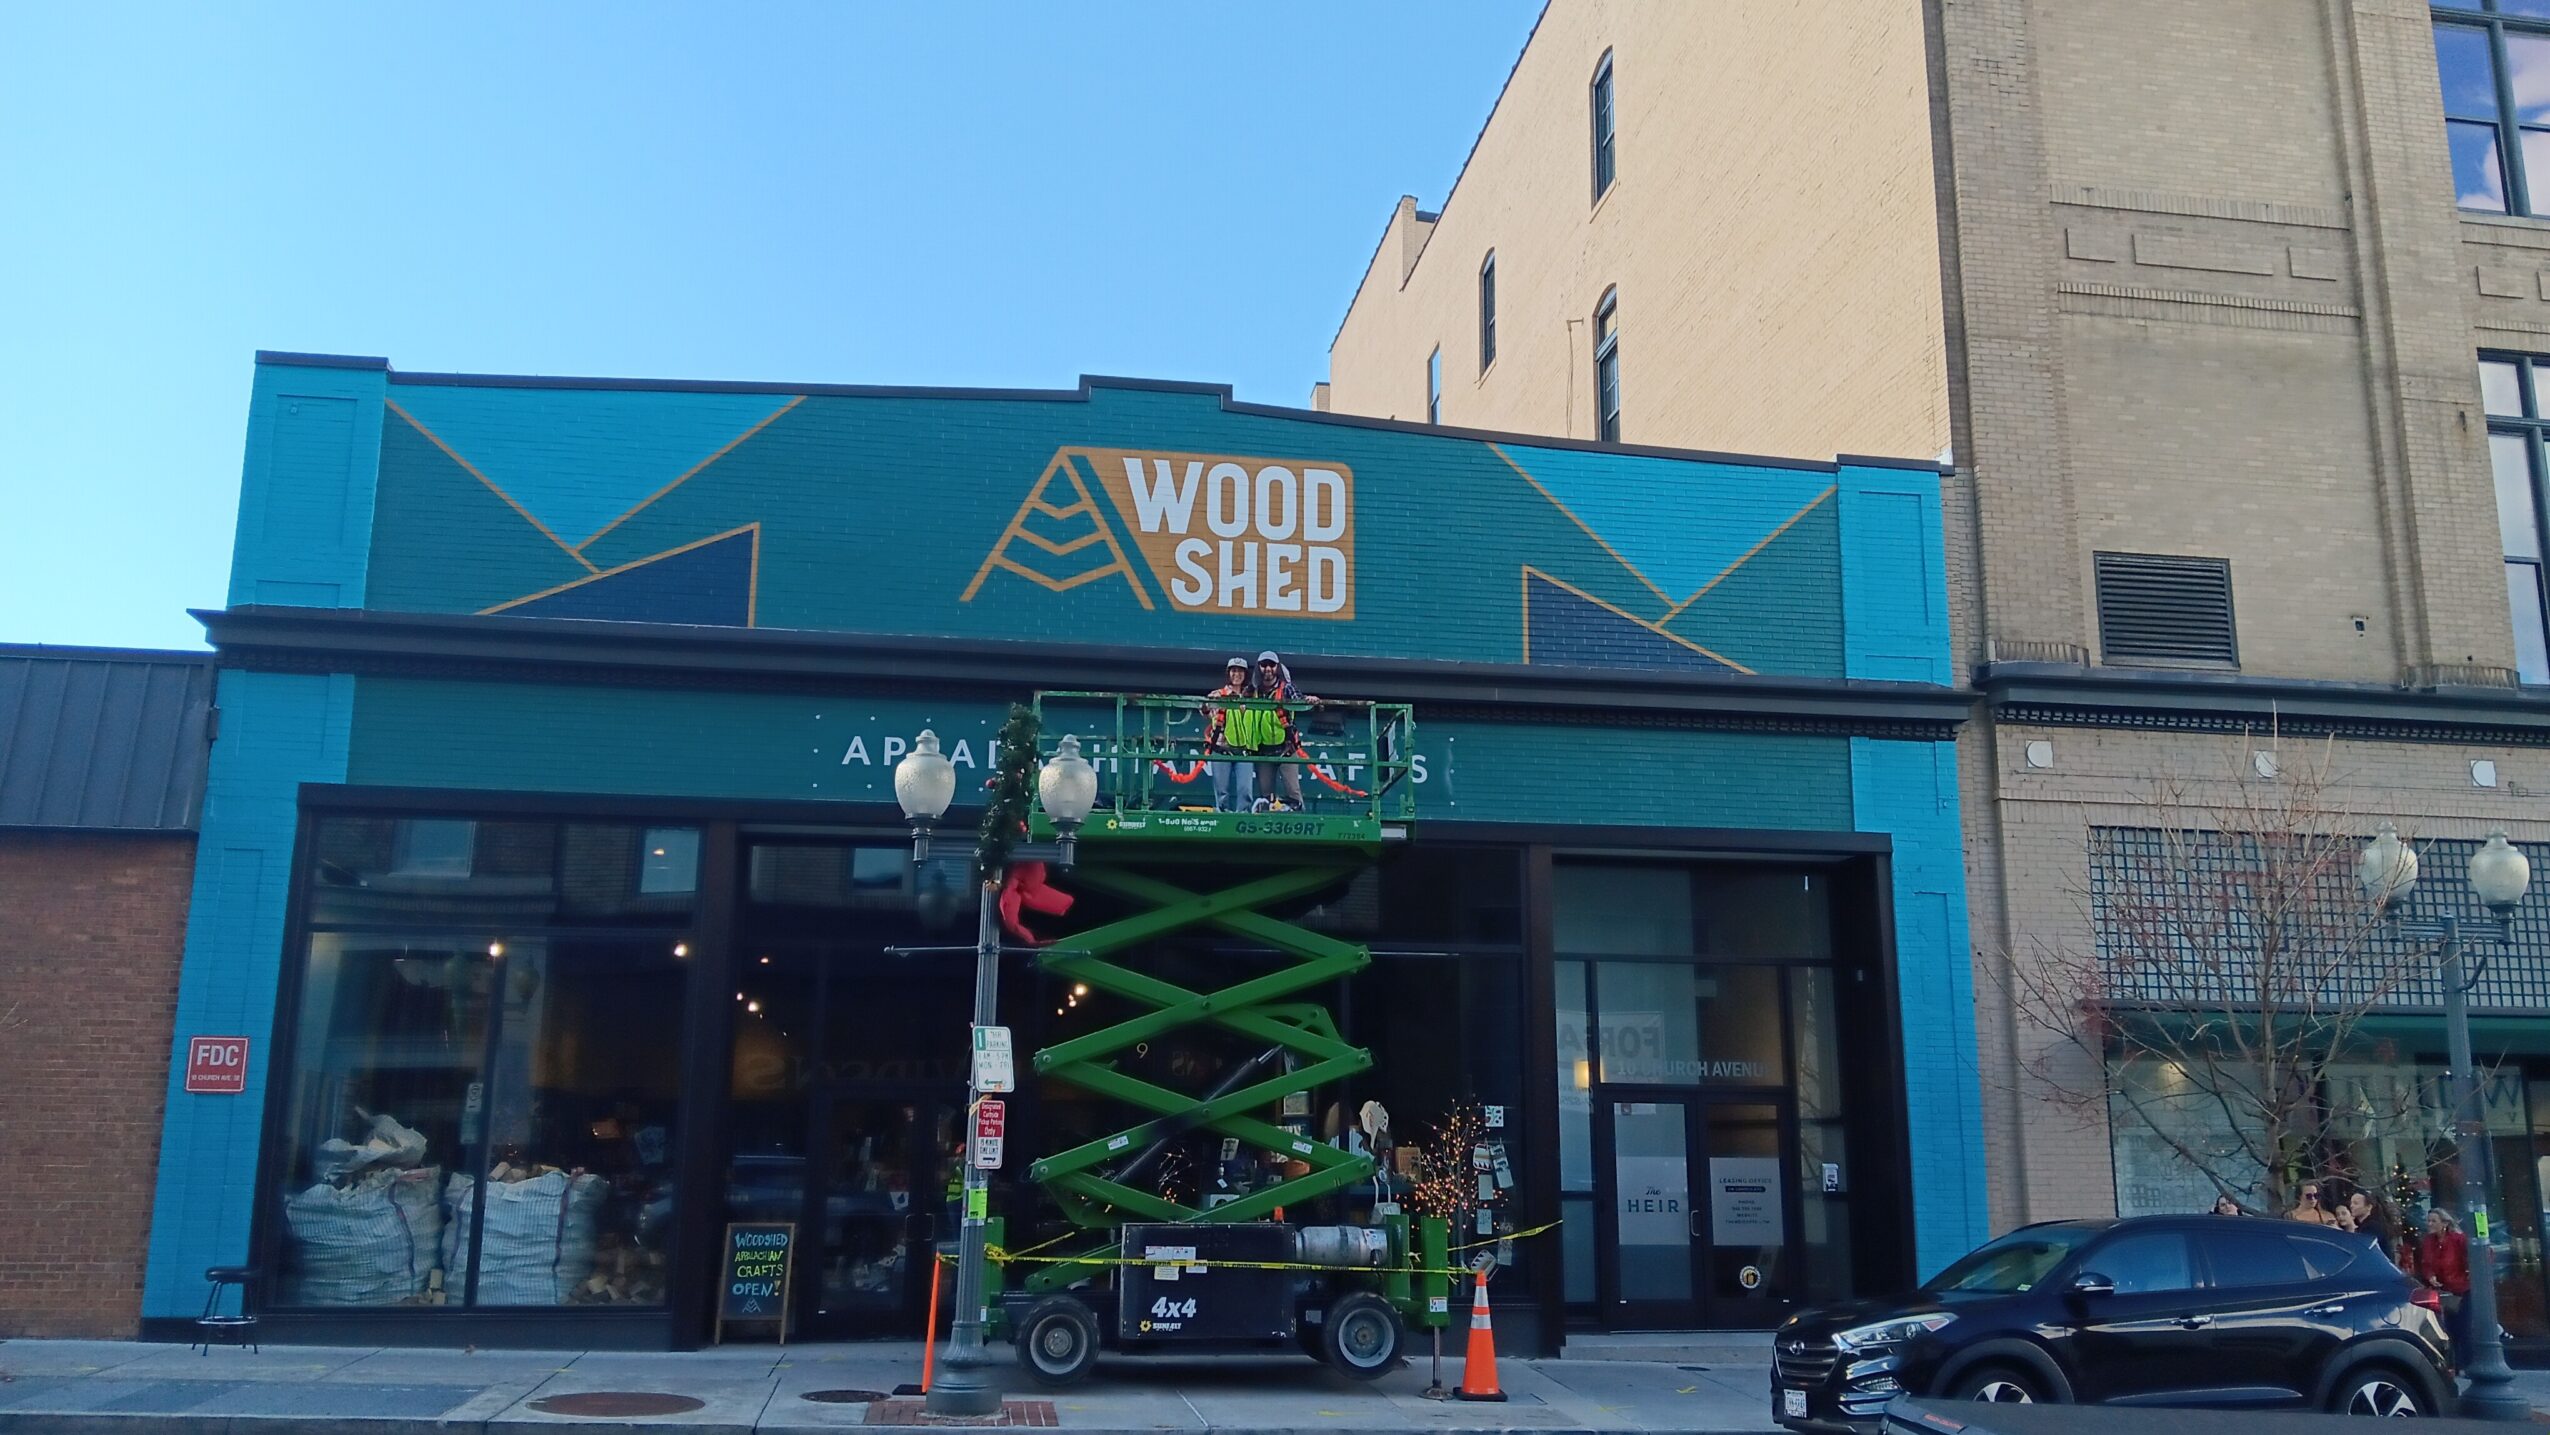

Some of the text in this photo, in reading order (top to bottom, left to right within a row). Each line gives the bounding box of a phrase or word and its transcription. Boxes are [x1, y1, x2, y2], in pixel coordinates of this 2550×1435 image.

[1123, 457, 1346, 542] WOOD
[1171, 538, 1347, 613] SHED
[1235, 820, 1325, 836] GS-3369RT
[977, 1031, 983, 1048] 1
[197, 1045, 239, 1067] FDC
[984, 1126, 996, 1137] Only
[1628, 1199, 1679, 1213] HEIR
[734, 1232, 788, 1249] WOODSHED
[737, 1264, 784, 1277] CRAFTS
[732, 1280, 781, 1297] OPEN!
[1151, 1297, 1197, 1318] 4x4
